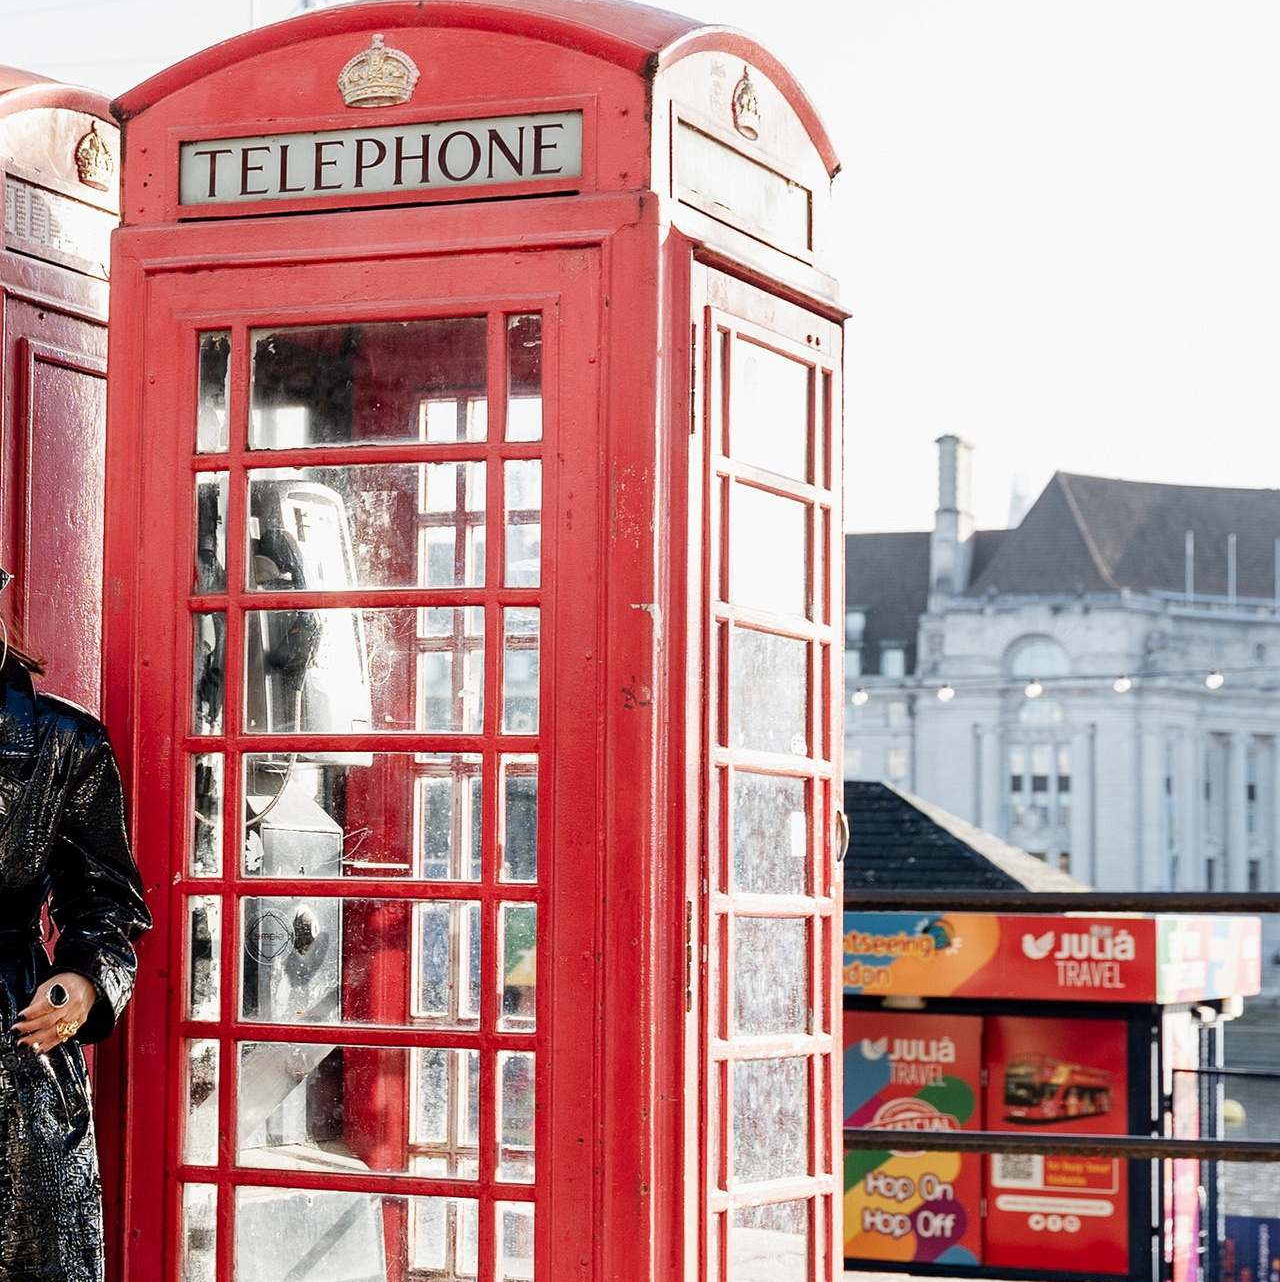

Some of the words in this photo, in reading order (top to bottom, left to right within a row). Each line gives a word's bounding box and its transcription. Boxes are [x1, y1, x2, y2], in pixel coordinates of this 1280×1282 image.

[193, 123, 564, 197] TELEPHONE
[1055, 960, 1126, 989] TRAVEL
[890, 1062, 947, 1087] TRAVEL
[865, 1171, 915, 1201] Hop
[919, 1173, 955, 1201] On
[862, 1207, 912, 1238] Hop
[916, 1210, 956, 1237] Off
